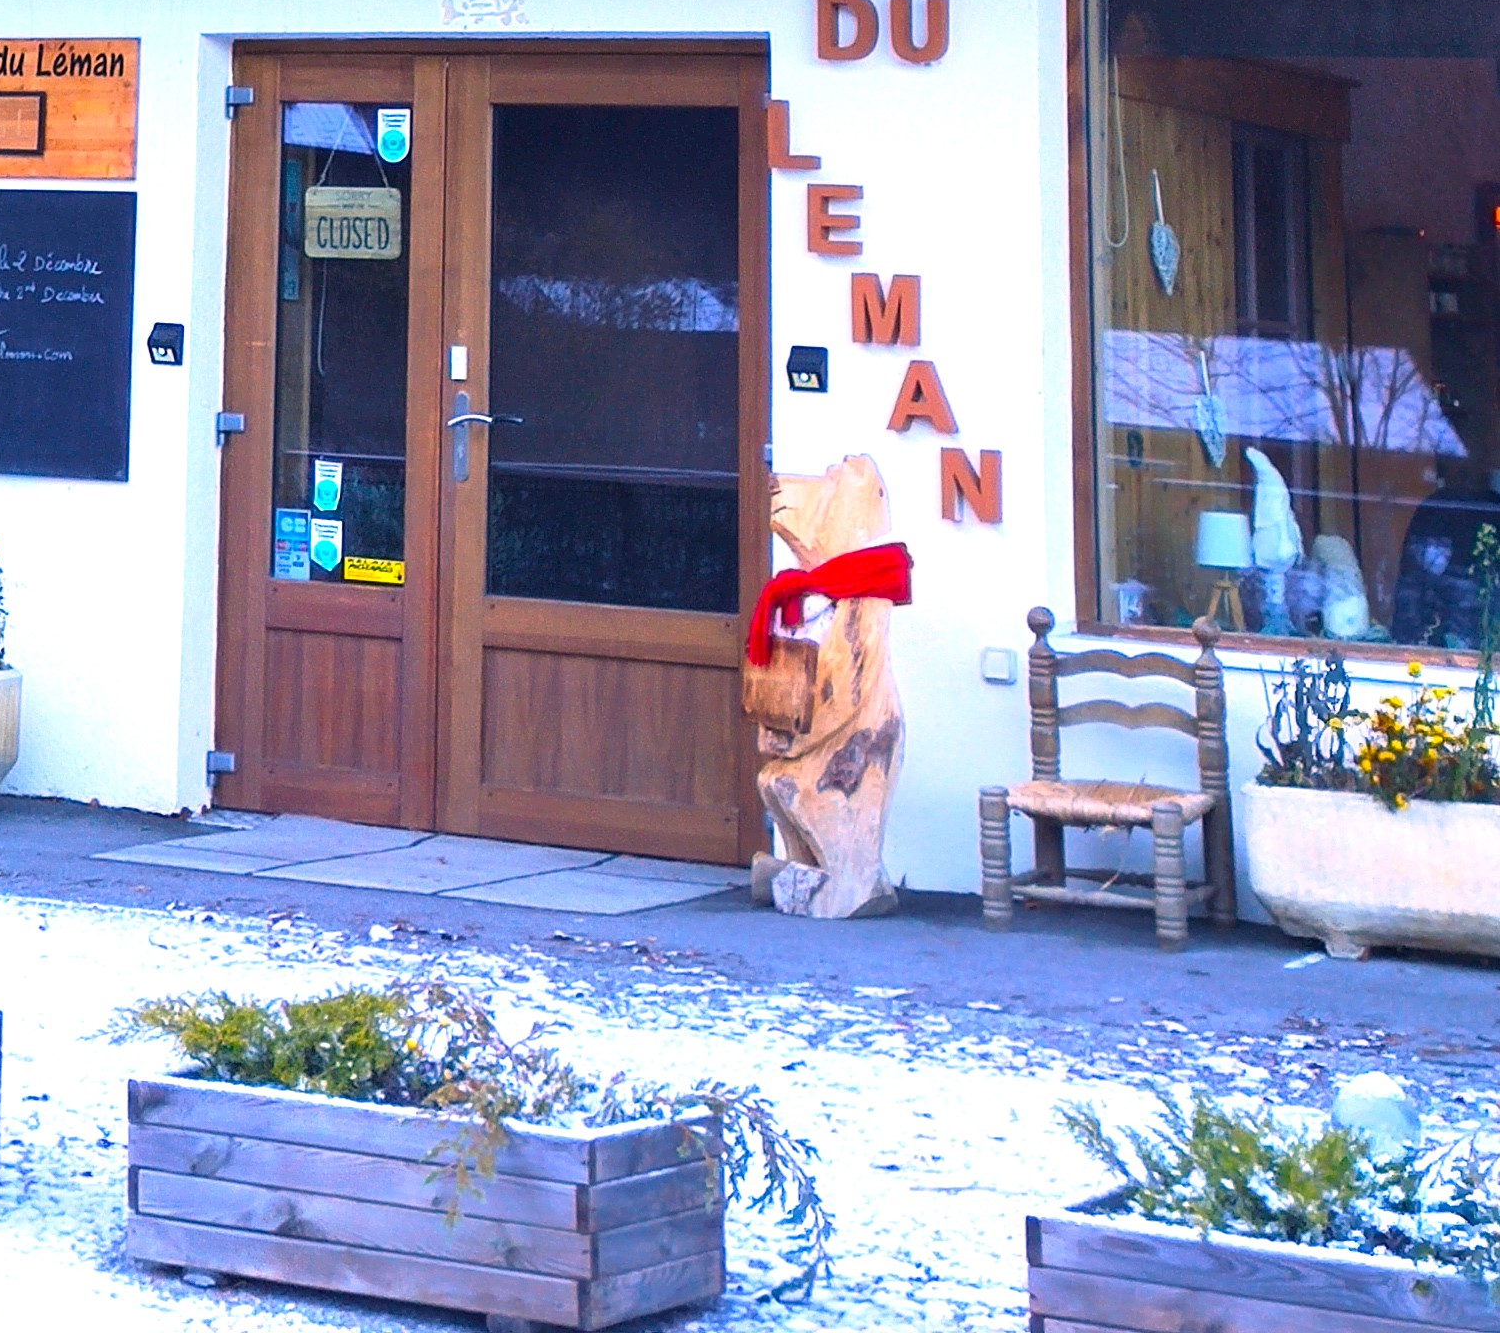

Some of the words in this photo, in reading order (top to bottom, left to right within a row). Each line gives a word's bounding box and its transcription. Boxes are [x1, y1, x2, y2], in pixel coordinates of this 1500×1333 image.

[36, 42, 125, 77] Léman
[316, 216, 390, 250] CLOSED
[767, 100, 1003, 524] LEMAN
